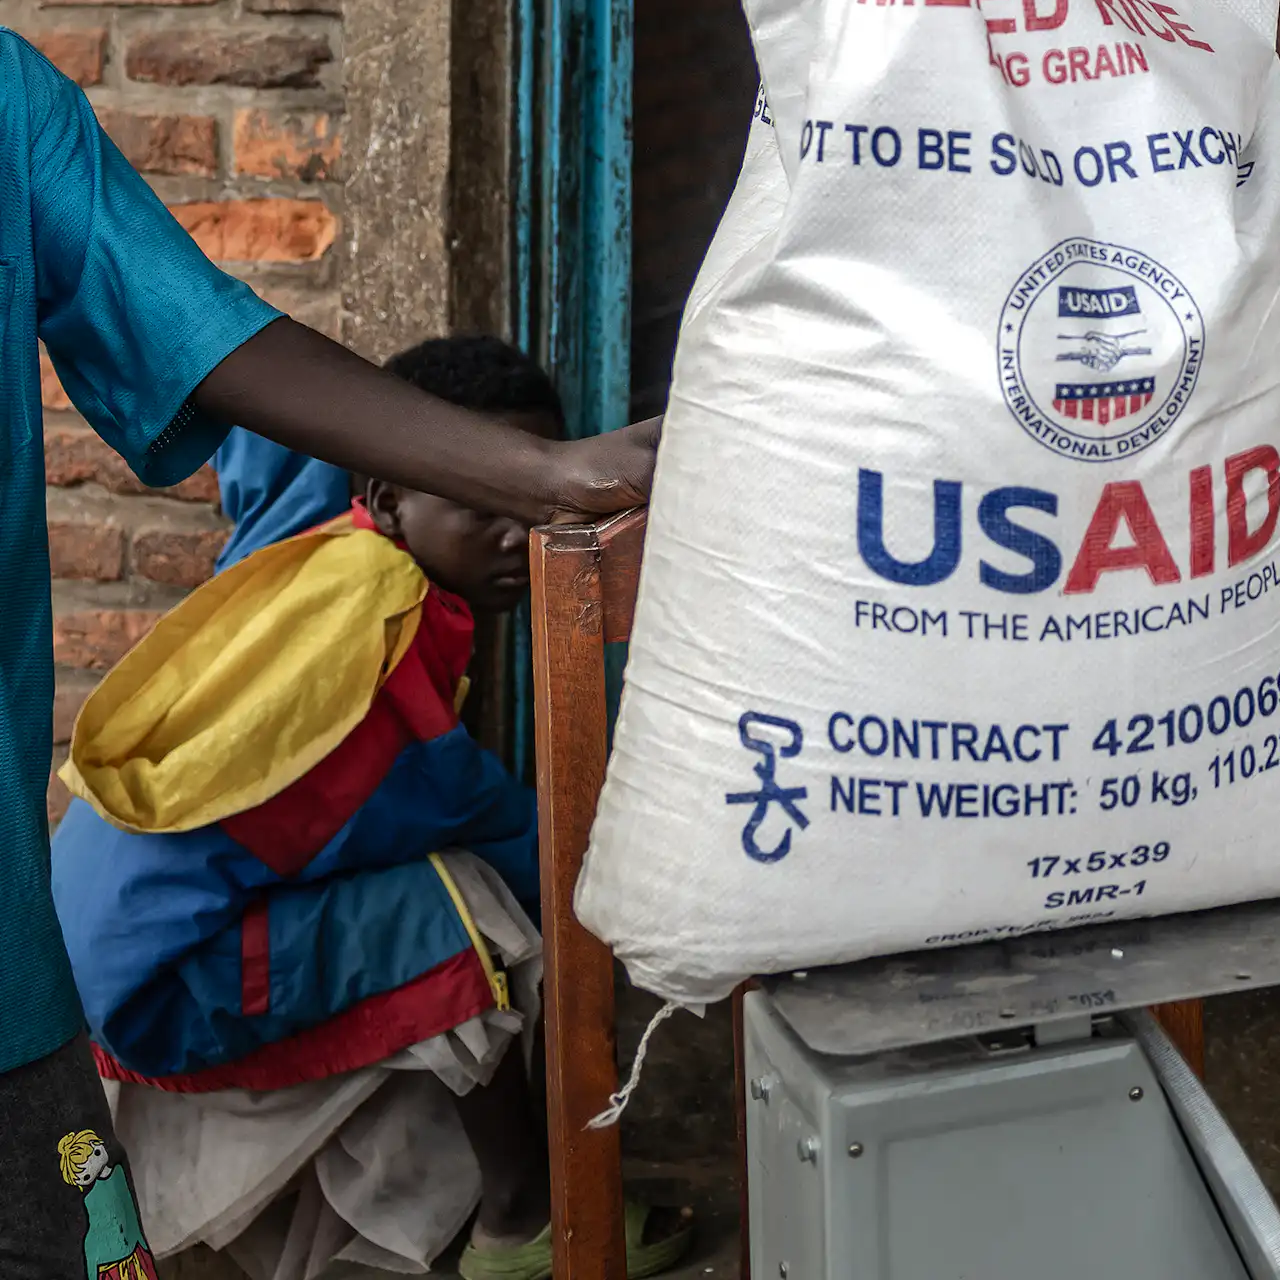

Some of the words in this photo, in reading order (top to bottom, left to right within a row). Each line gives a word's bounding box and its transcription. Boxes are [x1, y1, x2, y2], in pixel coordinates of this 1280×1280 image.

[1042, 42, 1150, 85] GRAIN
[800, 119, 834, 162] OT
[844, 123, 899, 168] TO
[918, 127, 972, 173] BE
[990, 132, 1063, 187] SOLD
[1073, 138, 1138, 188] OR
[1010, 251, 1065, 312] UNITED
[1065, 243, 1107, 262] STATES
[1111, 251, 1185, 301] AGENCY
[1066, 290, 1129, 314] USAID
[1002, 348, 1112, 457] INTERNATIONAL
[1117, 336, 1201, 454] DEVELOPMENT
[854, 600, 948, 638] FROM
[959, 611, 1029, 641] THE
[1039, 594, 1212, 643] AMERICAN
[828, 711, 1069, 763] CONTRACT
[829, 775, 909, 816] NET
[917, 781, 1078, 819] WEIGHT:
[1099, 774, 1142, 811] 50
[1151, 769, 1198, 807] kg,
[1026, 841, 1172, 879] 17x5x39
[1043, 880, 1147, 910] SMR-1
